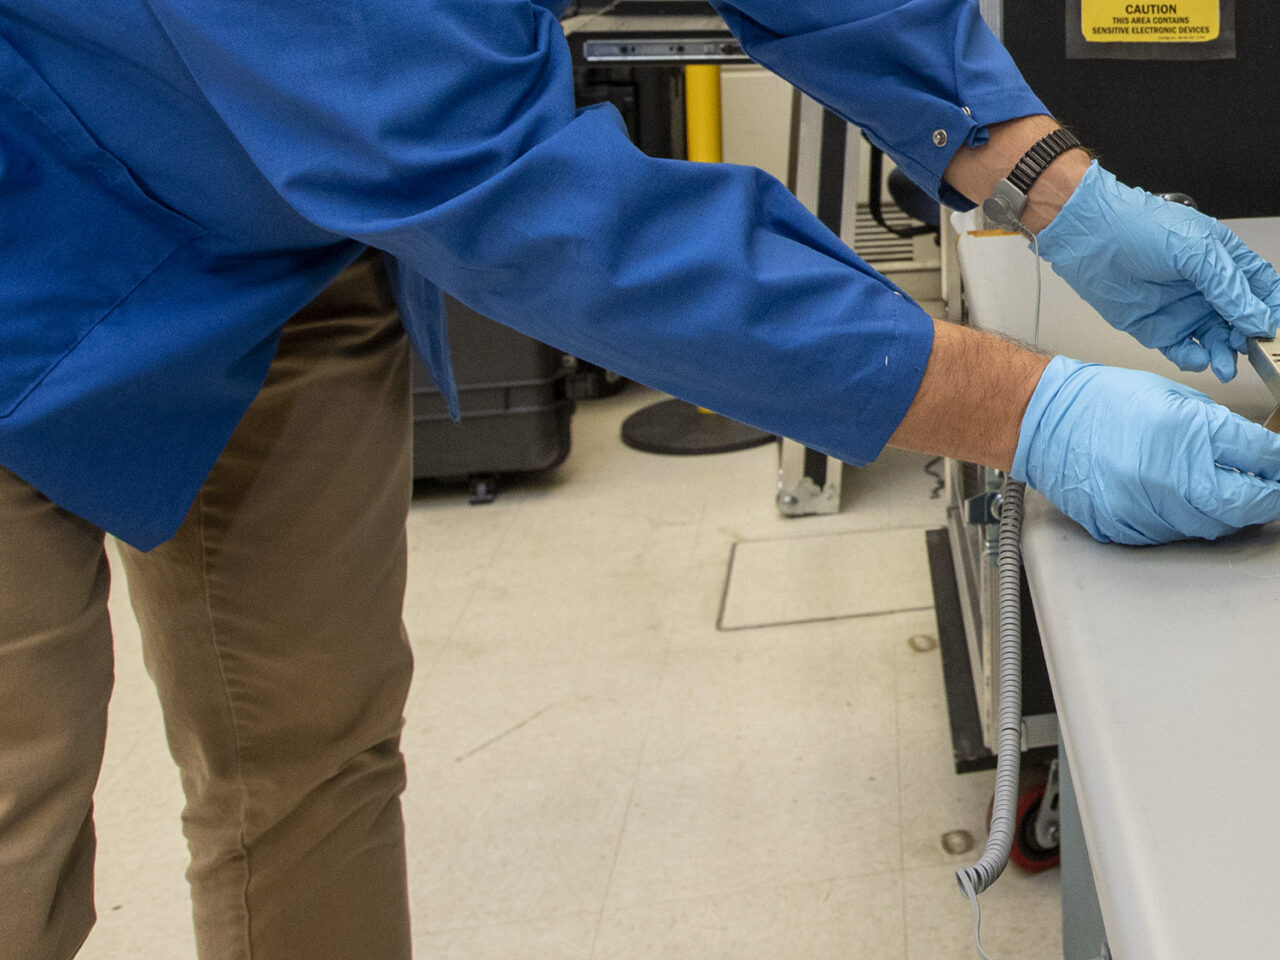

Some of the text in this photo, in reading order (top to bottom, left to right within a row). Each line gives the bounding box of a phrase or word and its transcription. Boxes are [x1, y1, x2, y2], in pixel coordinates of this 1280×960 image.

[1125, 4, 1177, 15] CAUTION
[1112, 16, 1190, 25] THIS AREA CONTAINS
[1092, 26, 1210, 35] SENSITIVE ELECTRONIC DEVICES
